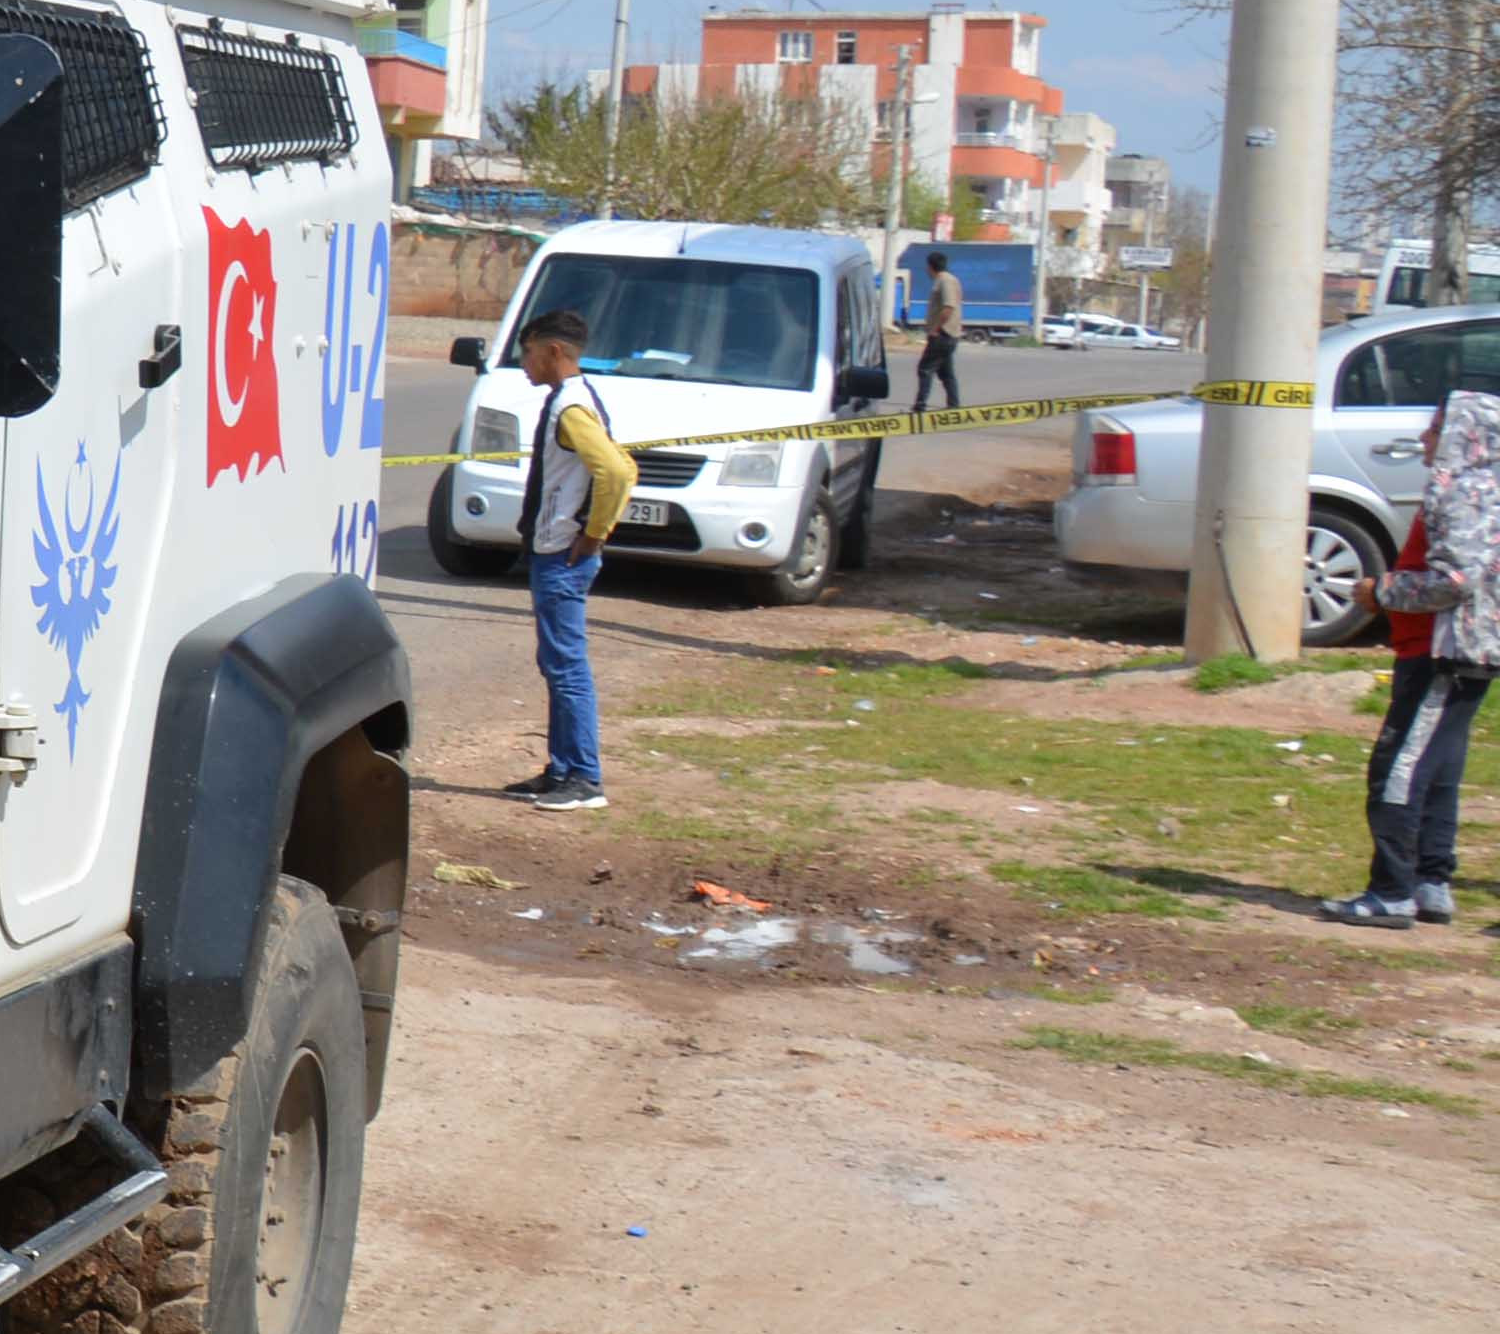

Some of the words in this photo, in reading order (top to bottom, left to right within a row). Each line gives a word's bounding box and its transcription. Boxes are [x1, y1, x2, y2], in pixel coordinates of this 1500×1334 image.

[930, 411, 976, 430] YERİ
[979, 405, 1037, 421] KAZA
[816, 417, 901, 438] GİRİLMEZ
